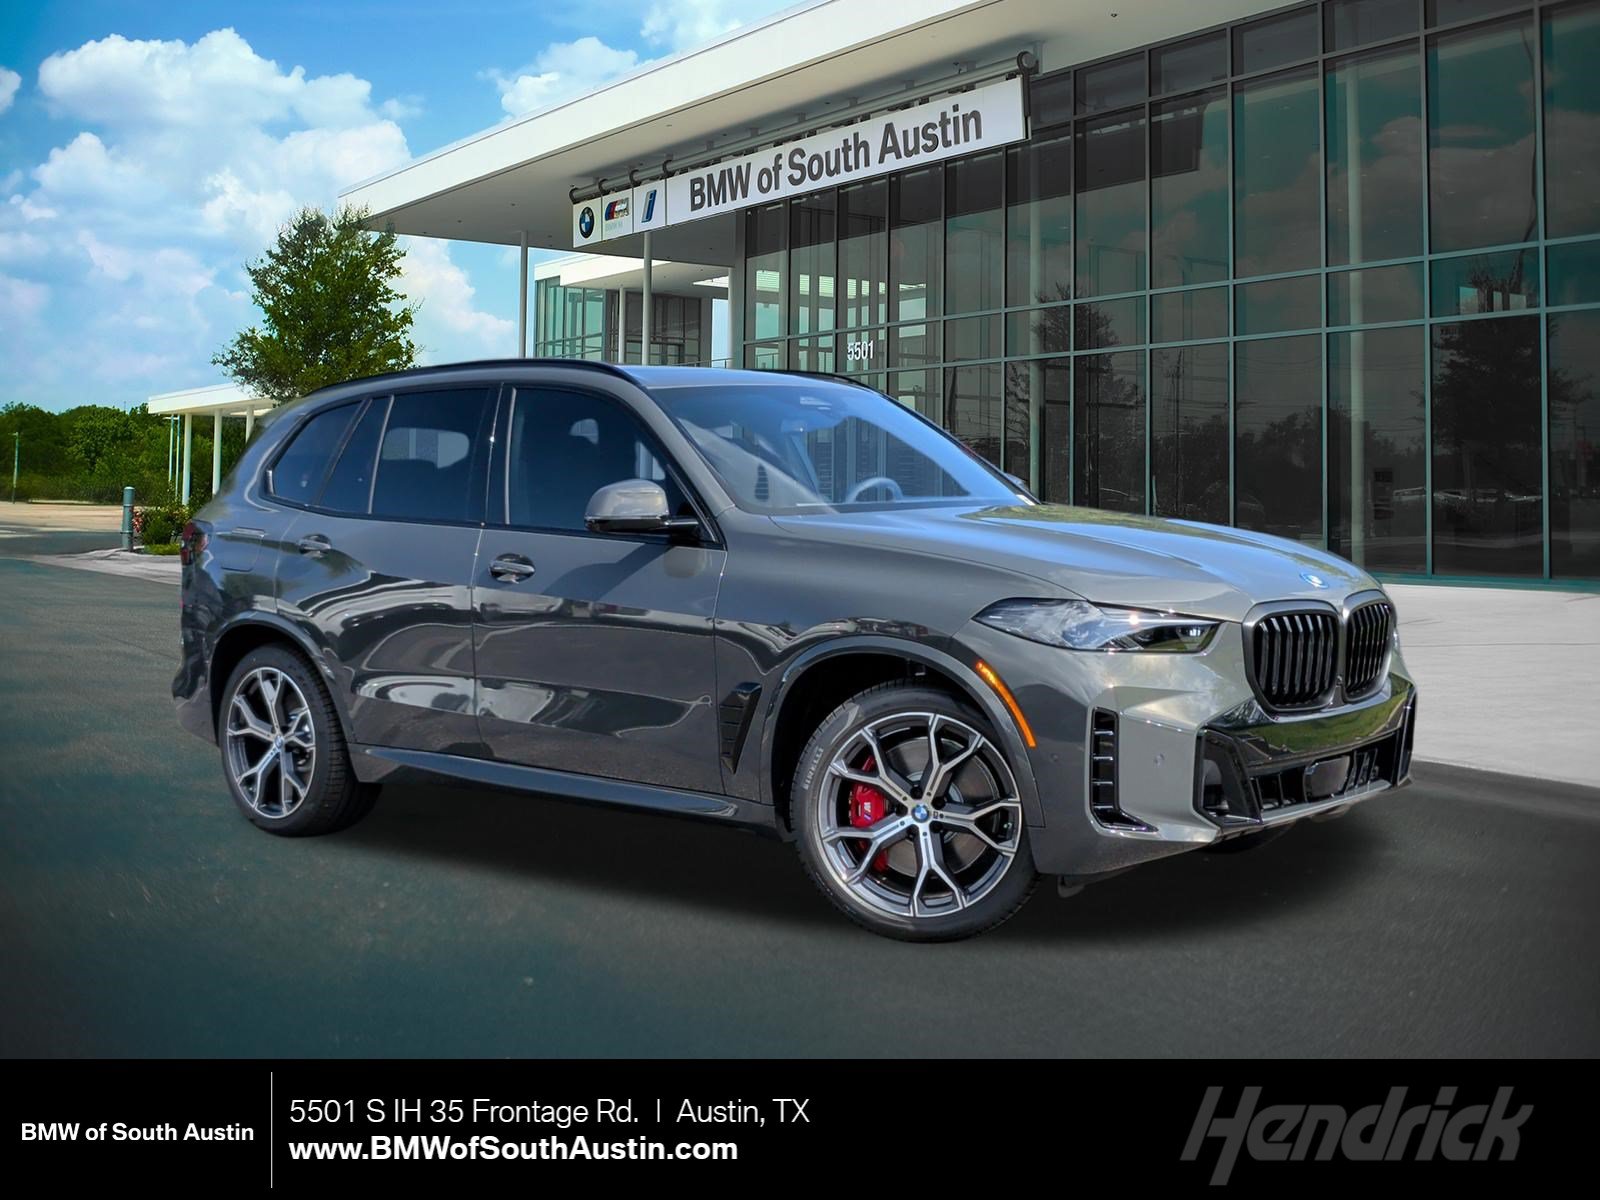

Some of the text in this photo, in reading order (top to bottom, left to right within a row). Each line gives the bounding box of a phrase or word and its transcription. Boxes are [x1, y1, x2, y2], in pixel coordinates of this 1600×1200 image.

[690, 162, 752, 212] BMW
[757, 153, 783, 194] of
[787, 131, 871, 186] South
[878, 103, 982, 164] Austin
[847, 340, 874, 361] 5501
